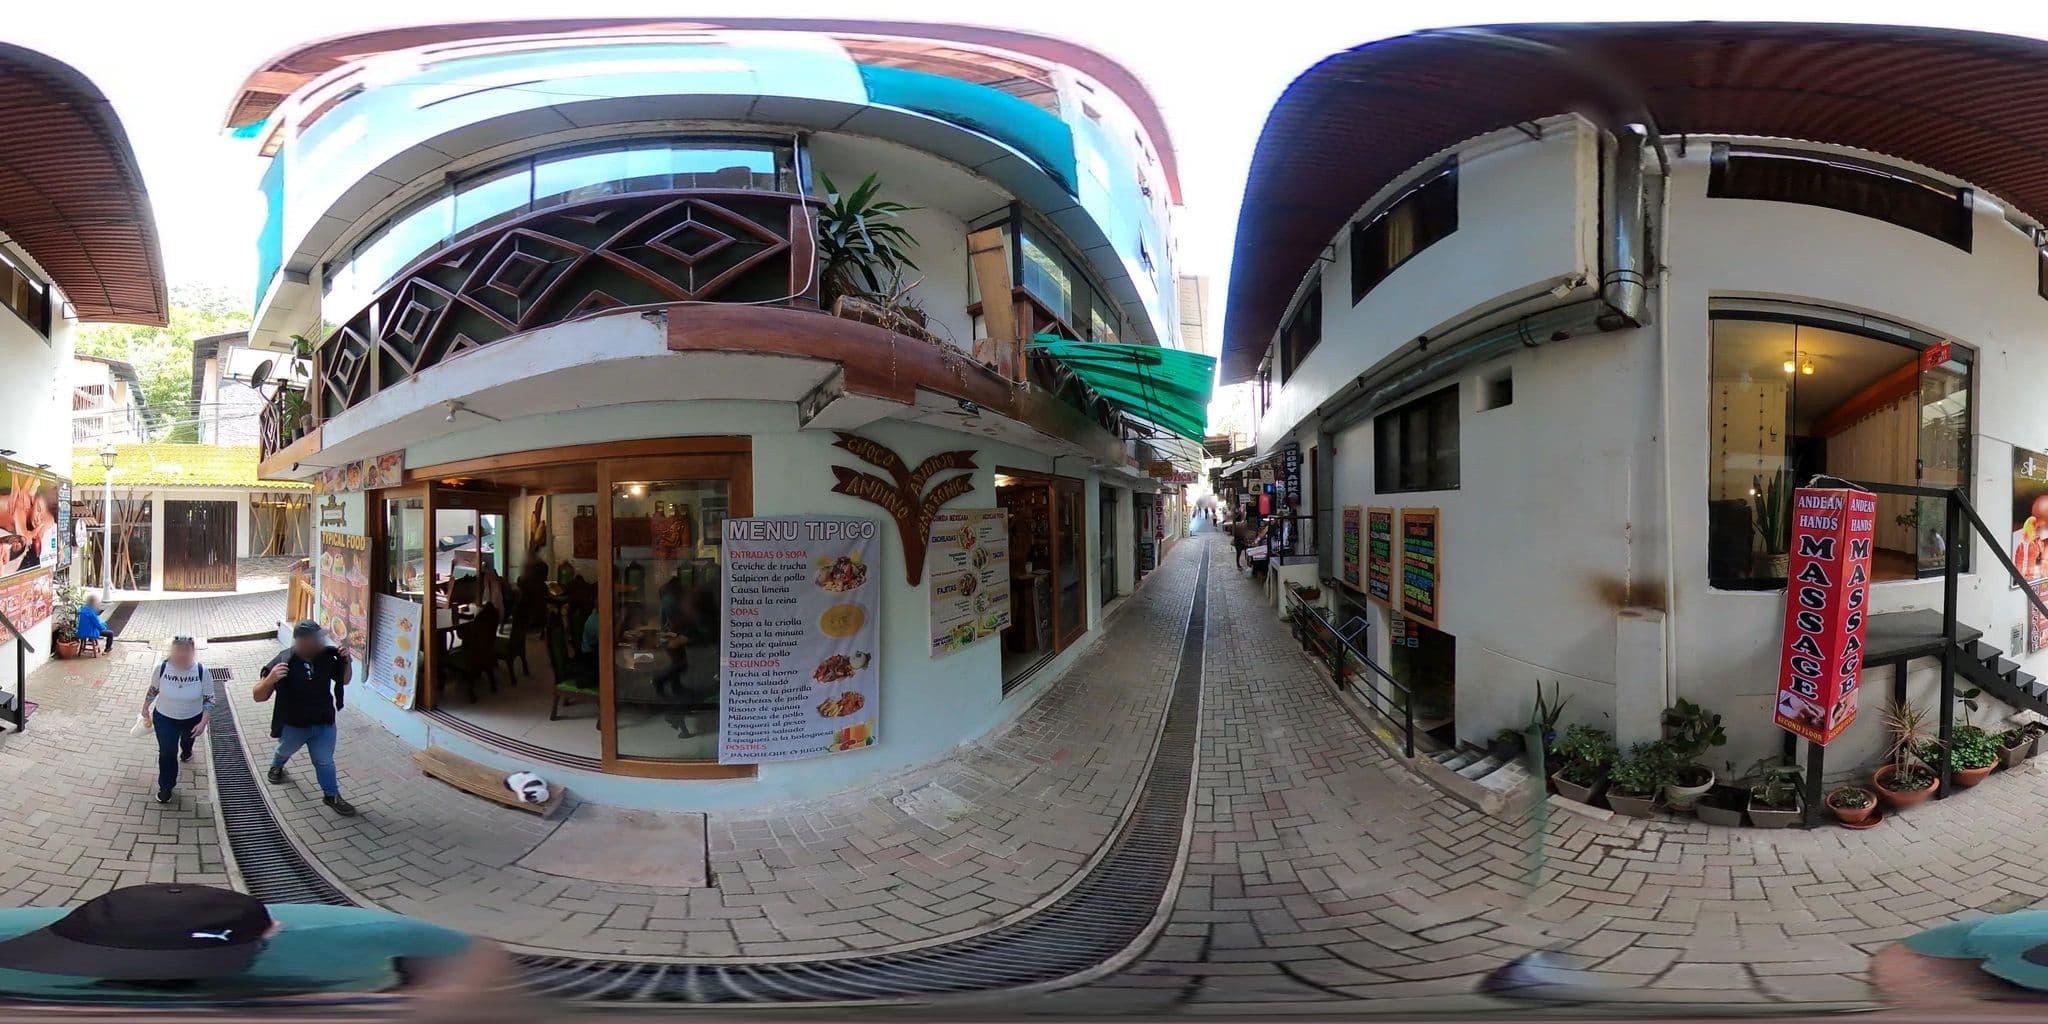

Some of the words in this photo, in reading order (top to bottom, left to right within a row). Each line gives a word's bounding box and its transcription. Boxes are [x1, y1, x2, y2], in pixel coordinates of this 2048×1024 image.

[845, 475, 910, 520] ANDINO
[1798, 495, 1843, 510] ANDEAN
[1850, 498, 1875, 513] ANDEAN
[1156, 501, 1164, 540] BOTICA
[1799, 515, 1838, 530] HANDS
[1851, 518, 1872, 532] HANDS
[729, 520, 799, 541] MENU
[806, 521, 876, 541] TIPICO
[322, 532, 345, 547] TYPICAL
[346, 535, 366, 550] FOOD
[731, 562, 765, 570] Ceviche
[731, 574, 768, 583] Salpicon
[784, 574, 805, 584] pollo
[730, 620, 753, 629] Sopa
[775, 618, 801, 626] criolla
[1790, 534, 1835, 700] MASSAGE
[1839, 538, 1871, 699] MASSAGE
[730, 630, 752, 639] Sopa
[730, 641, 752, 649] Sopa
[768, 641, 797, 650] quinua
[768, 650, 790, 659] pollo
[729, 659, 780, 668] SEGUNDOS
[781, 686, 812, 696] parrilla
[786, 695, 809, 703] pollo
[782, 712, 804, 720] pollo
[1777, 716, 1801, 731] SECOND
[1802, 728, 1822, 741] FLOOR
